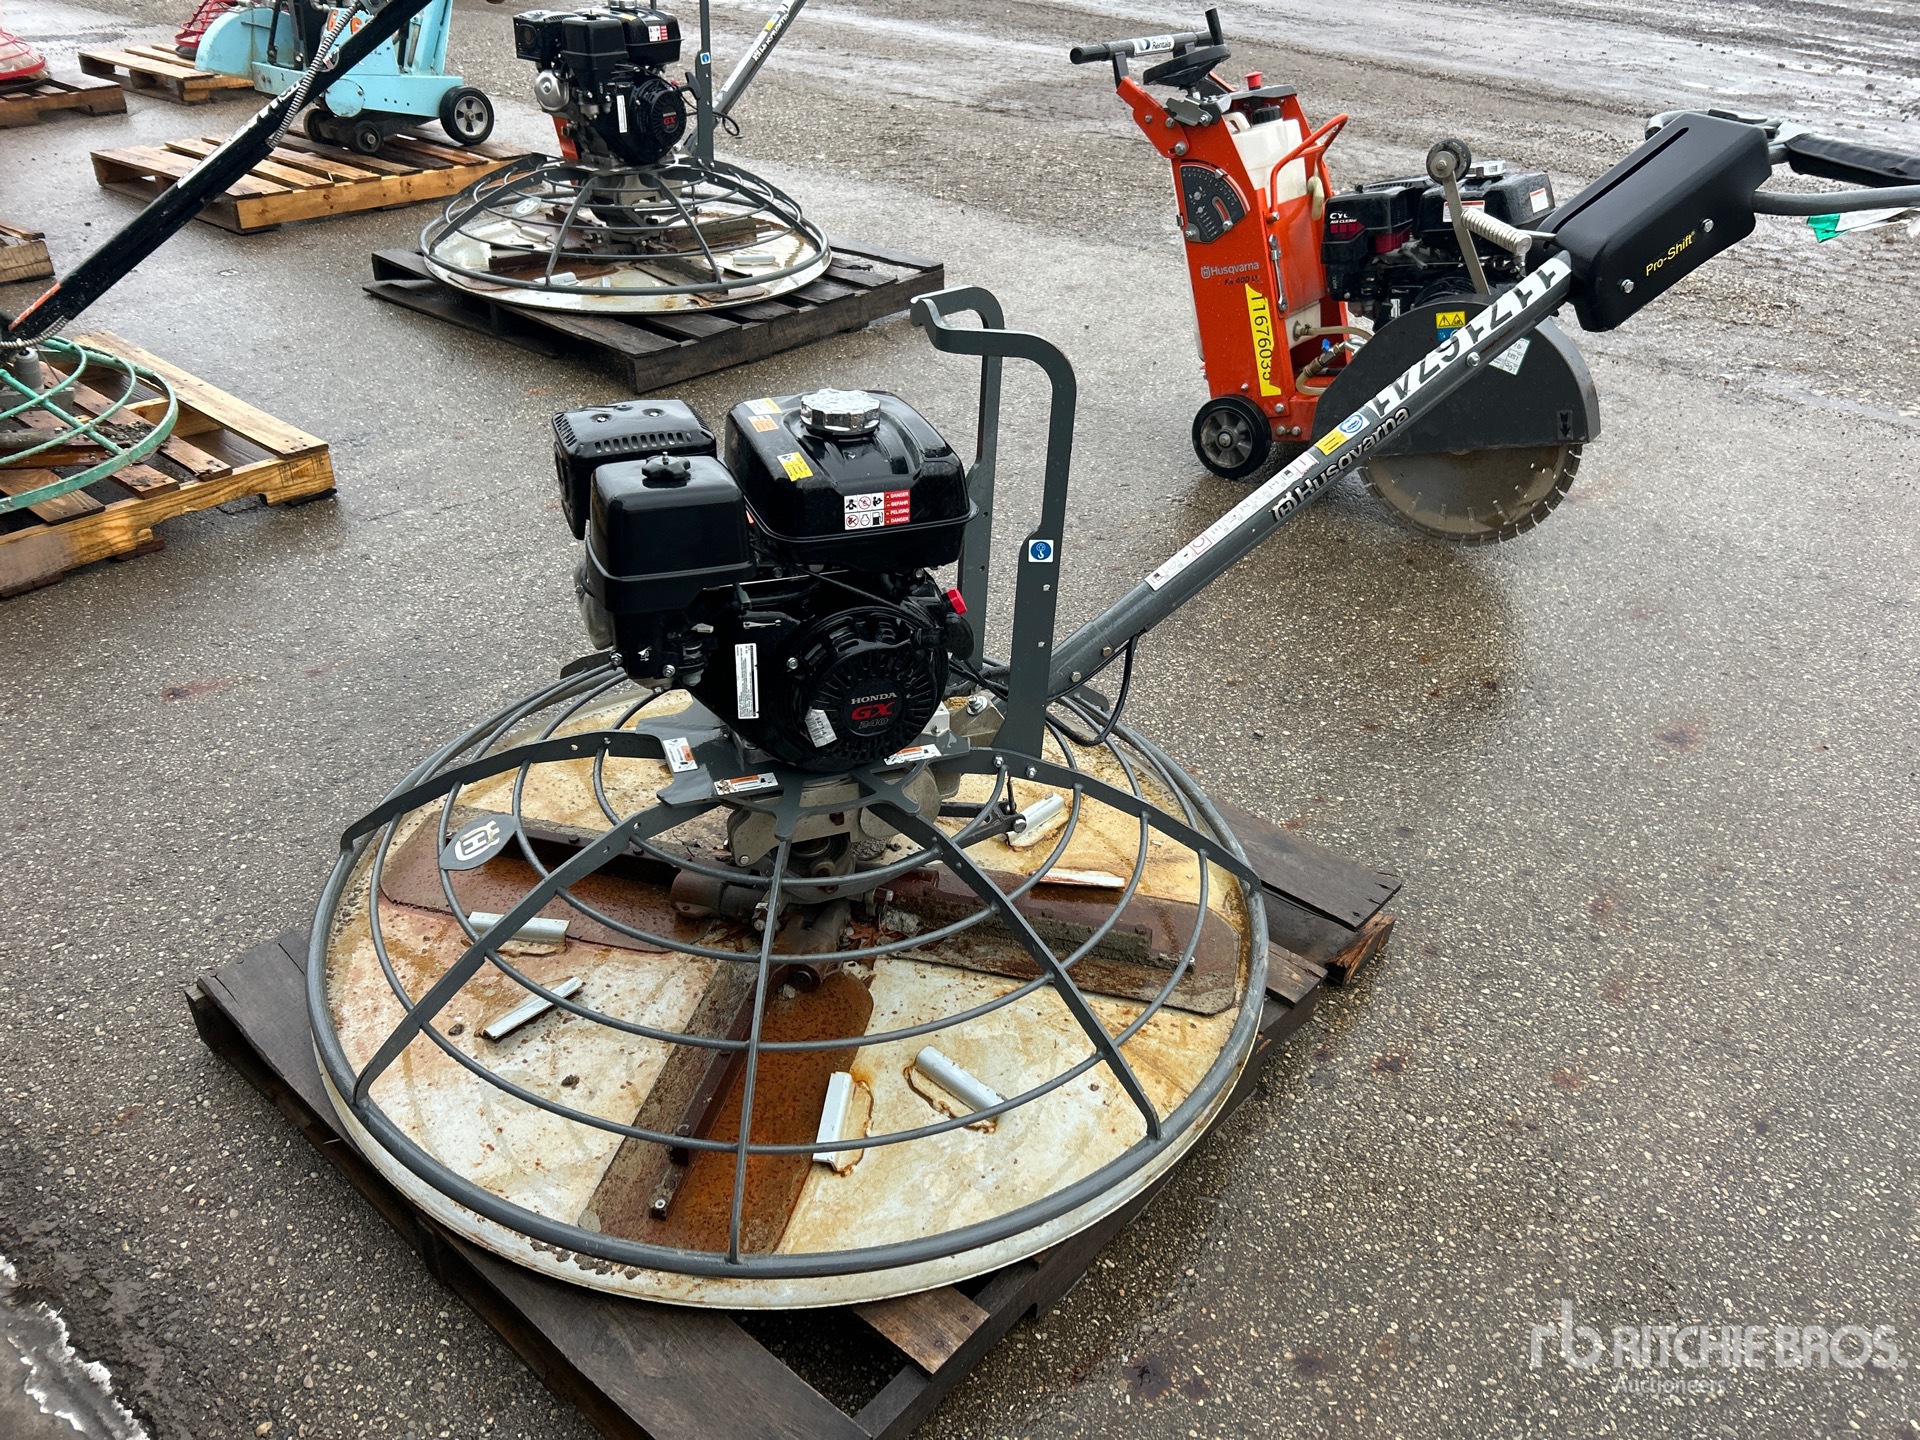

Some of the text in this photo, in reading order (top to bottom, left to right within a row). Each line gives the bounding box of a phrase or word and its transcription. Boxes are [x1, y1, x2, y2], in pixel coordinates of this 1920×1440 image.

[1210, 262, 1260, 276] Husqvarna
[1294, 407, 1410, 502] Husqvarna
[890, 491, 909, 499] DANGER
[851, 692, 897, 705] HONDA
[851, 701, 895, 720] GX
